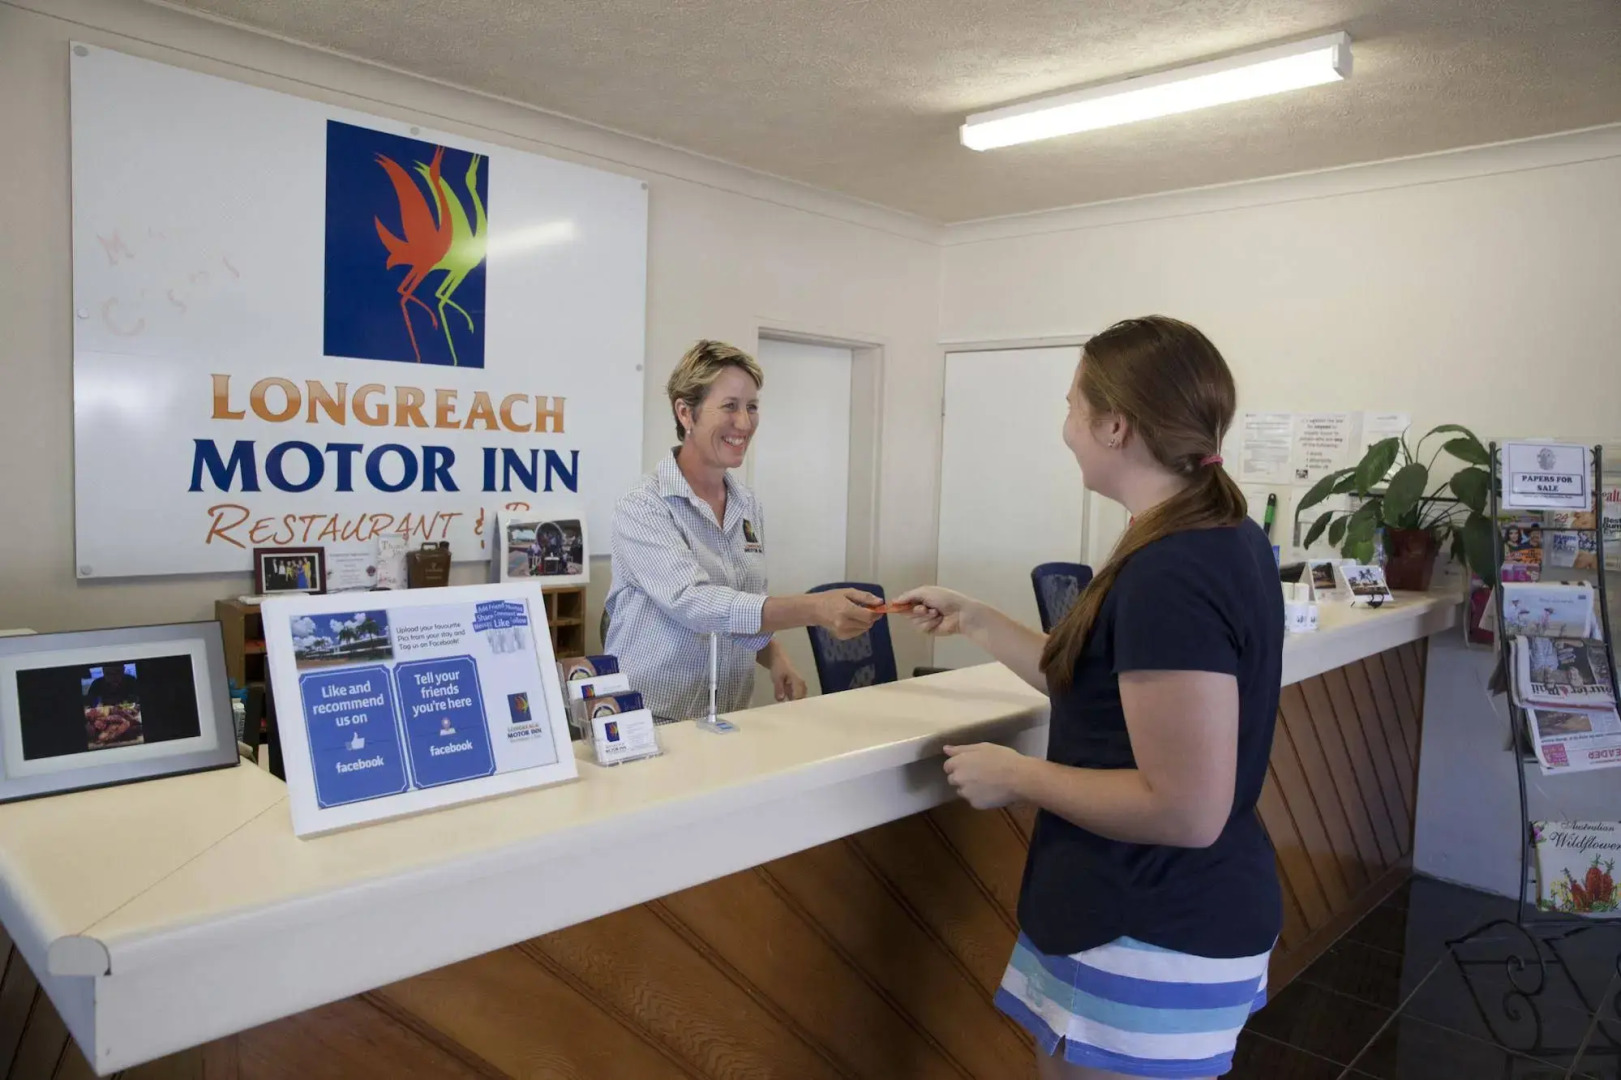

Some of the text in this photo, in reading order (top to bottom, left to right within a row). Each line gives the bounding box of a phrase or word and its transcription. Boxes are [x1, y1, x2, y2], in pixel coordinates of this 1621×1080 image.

[211, 373, 567, 434] LONGREACH
[188, 438, 580, 494] MOTOR INN
[1522, 475, 1573, 484] PAPERS FOR
[205, 503, 464, 549] RESTAURANT
[396, 625, 419, 634] Upload
[420, 624, 434, 633] your
[493, 618, 510, 628] Like
[414, 671, 460, 686] Tell your
[321, 680, 371, 699] Like and
[421, 683, 460, 699] friends
[312, 693, 385, 715] recommend
[412, 697, 473, 718] you're here
[335, 713, 368, 727] us on
[429, 739, 473, 757] facebook
[1588, 748, 1621, 760] EADER
[336, 755, 384, 773] facebook
[1562, 821, 1615, 832] Australian
